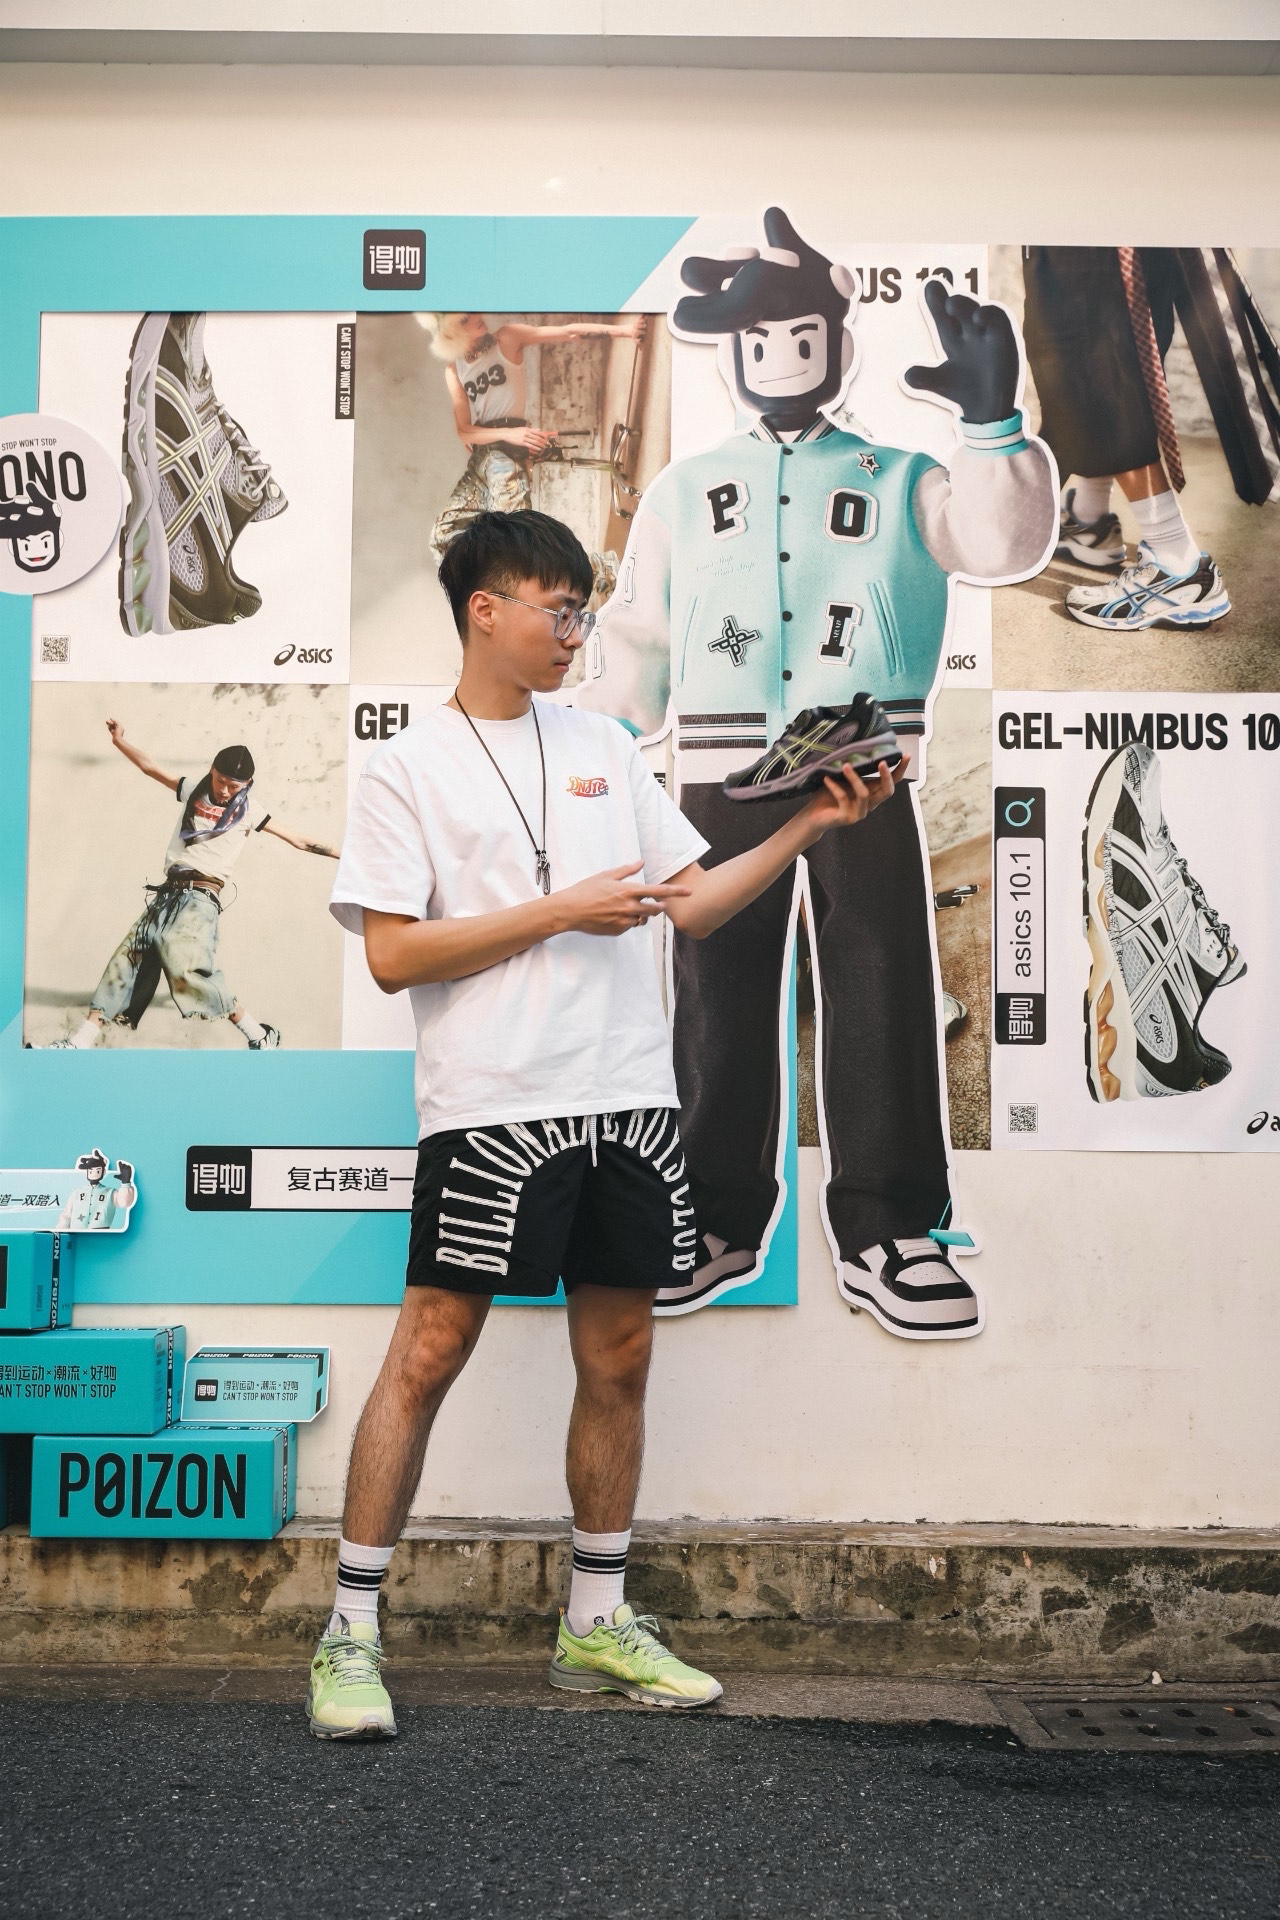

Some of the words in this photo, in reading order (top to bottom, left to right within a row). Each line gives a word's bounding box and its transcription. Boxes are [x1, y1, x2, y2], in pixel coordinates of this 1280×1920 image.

[369, 245, 421, 275] 得物
[340, 327, 352, 349] CAN'T
[340, 350, 351, 370] STOP
[339, 370, 351, 395] WON'T
[339, 395, 351, 416] STOP
[1, 440, 18, 451] STOP
[18, 438, 39, 448] WON'T
[40, 438, 57, 446] STOP
[706, 482, 741, 535] P
[297, 648, 333, 664] asics
[1009, 853, 1032, 902] 10.1
[1009, 909, 1032, 978] asics
[1008, 997, 1033, 1040] 得物
[192, 1163, 246, 1195] 得物
[287, 1166, 415, 1192] 复古赛道一
[24, 1384, 51, 1398] STOP
[53, 1384, 87, 1398] WON'T
[90, 1384, 117, 1398] STOP
[197, 1384, 217, 1397] 得物
[222, 1392, 241, 1401] CAN'T
[242, 1392, 259, 1401] STOP
[260, 1392, 280, 1401] WON'T
[281, 1392, 299, 1401] STOP
